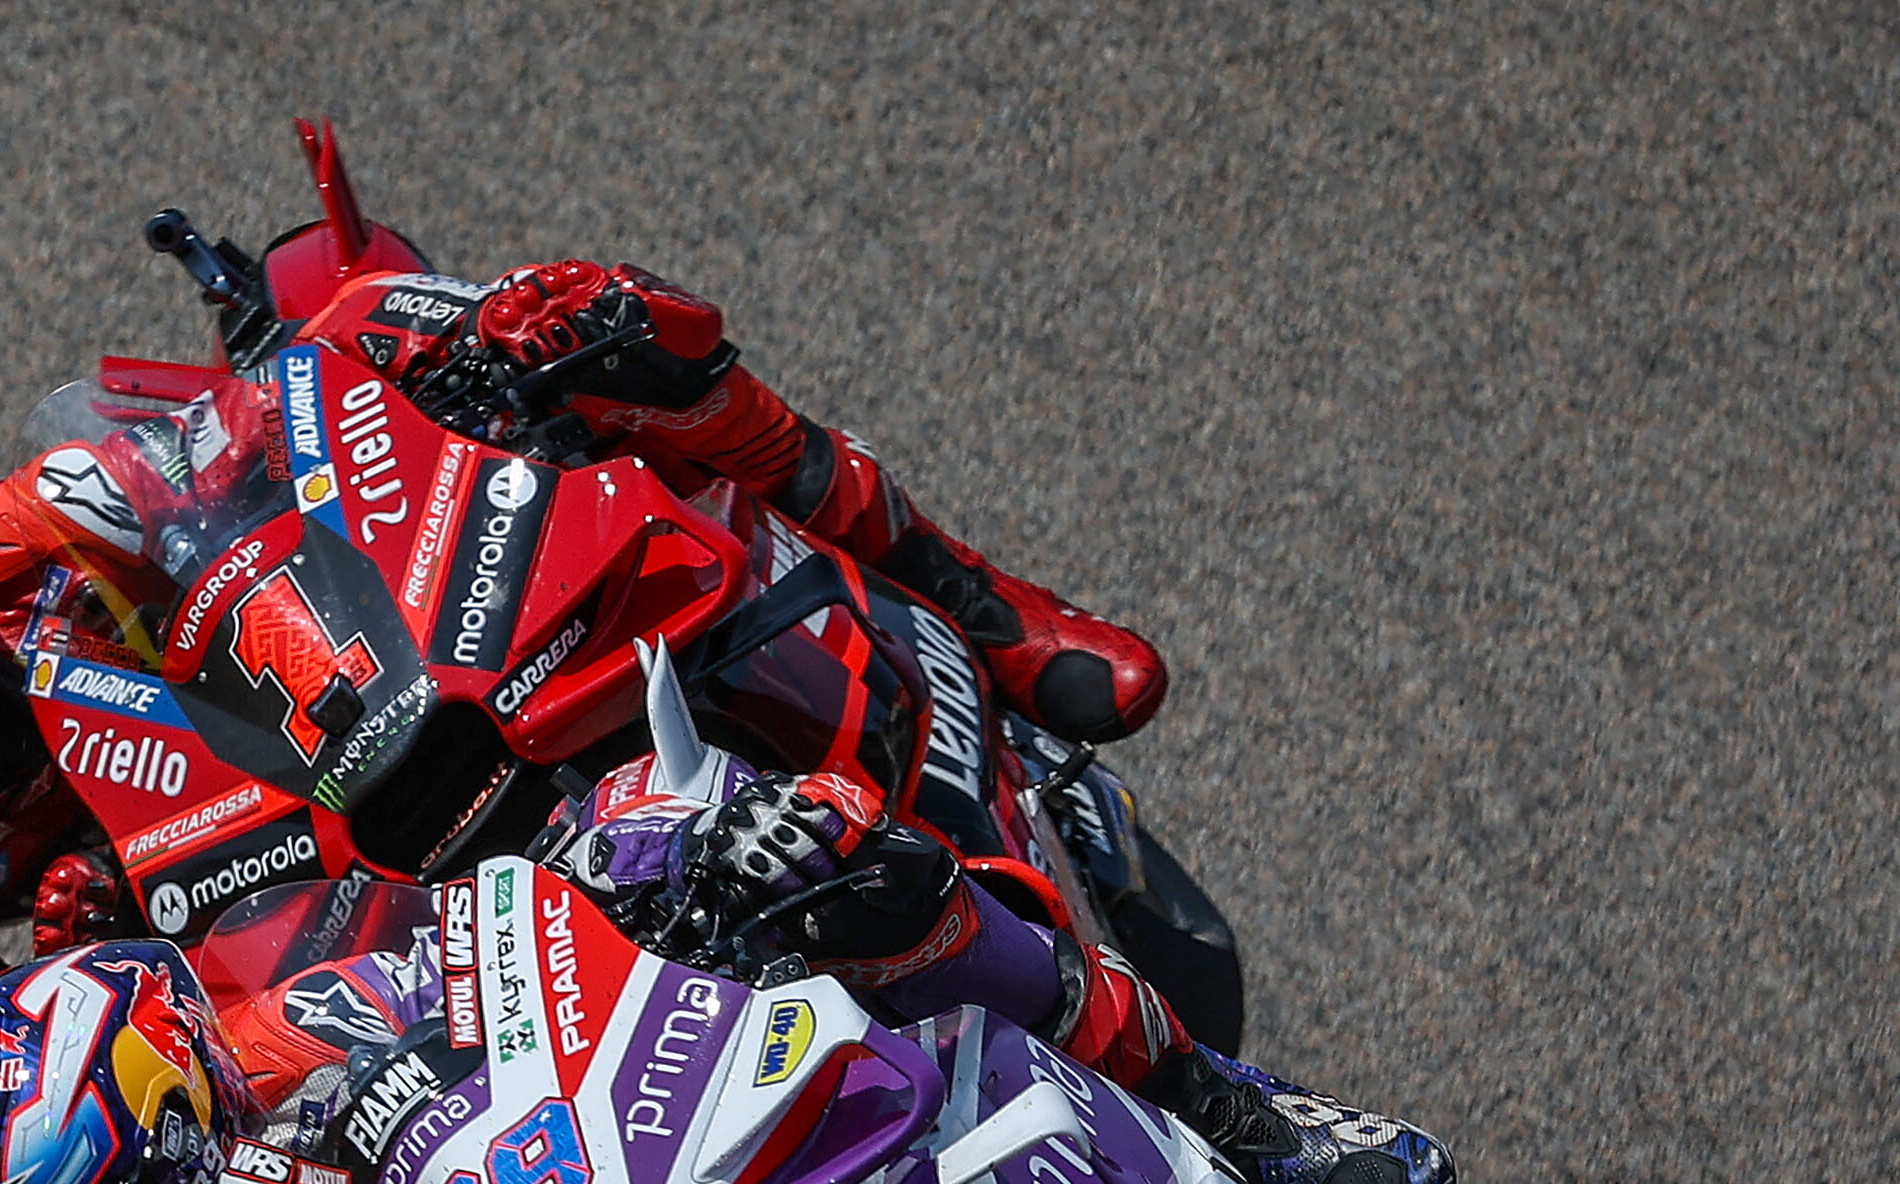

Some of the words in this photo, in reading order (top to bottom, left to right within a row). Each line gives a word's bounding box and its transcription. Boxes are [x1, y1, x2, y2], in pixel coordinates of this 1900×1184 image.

[384, 291, 465, 327] Lenovo
[287, 356, 323, 459] ADVANCE
[404, 441, 464, 608] FRECCIAROSSA
[176, 540, 264, 652] VARGROUP
[451, 514, 515, 663] motorola
[58, 667, 160, 712] ADVANCE
[493, 618, 588, 715] CARRERA
[909, 605, 980, 802] Lenovo
[357, 703, 424, 772] ENERG
[125, 785, 262, 860] FRECCIAROSSA
[191, 832, 317, 909] motorola
[307, 868, 372, 962] CARRERA
[446, 886, 474, 968] WRS
[542, 891, 590, 1056] PRAMAC
[450, 977, 480, 1044] MOTUL
[760, 1005, 799, 1079] WD-40
[345, 1052, 437, 1158] FIAMM
[625, 977, 719, 1143] prima
[229, 1143, 292, 1184] WRS
